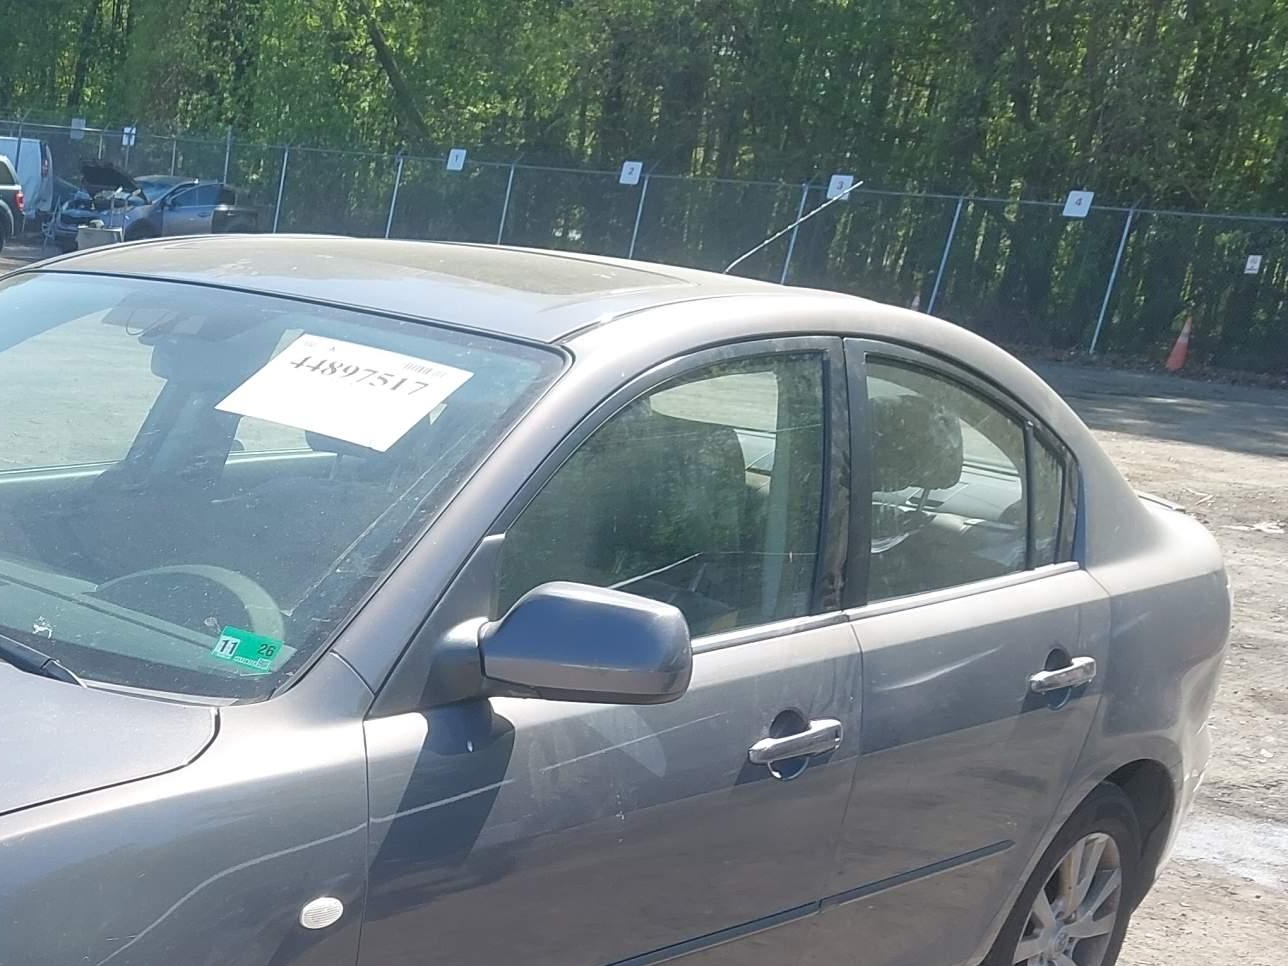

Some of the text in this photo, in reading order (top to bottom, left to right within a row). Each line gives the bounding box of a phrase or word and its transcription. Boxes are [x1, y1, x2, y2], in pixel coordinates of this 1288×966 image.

[836, 181, 844, 190] 3
[1075, 197, 1082, 206] 4
[289, 355, 430, 396] 44897517
[219, 639, 276, 657] 11 26
